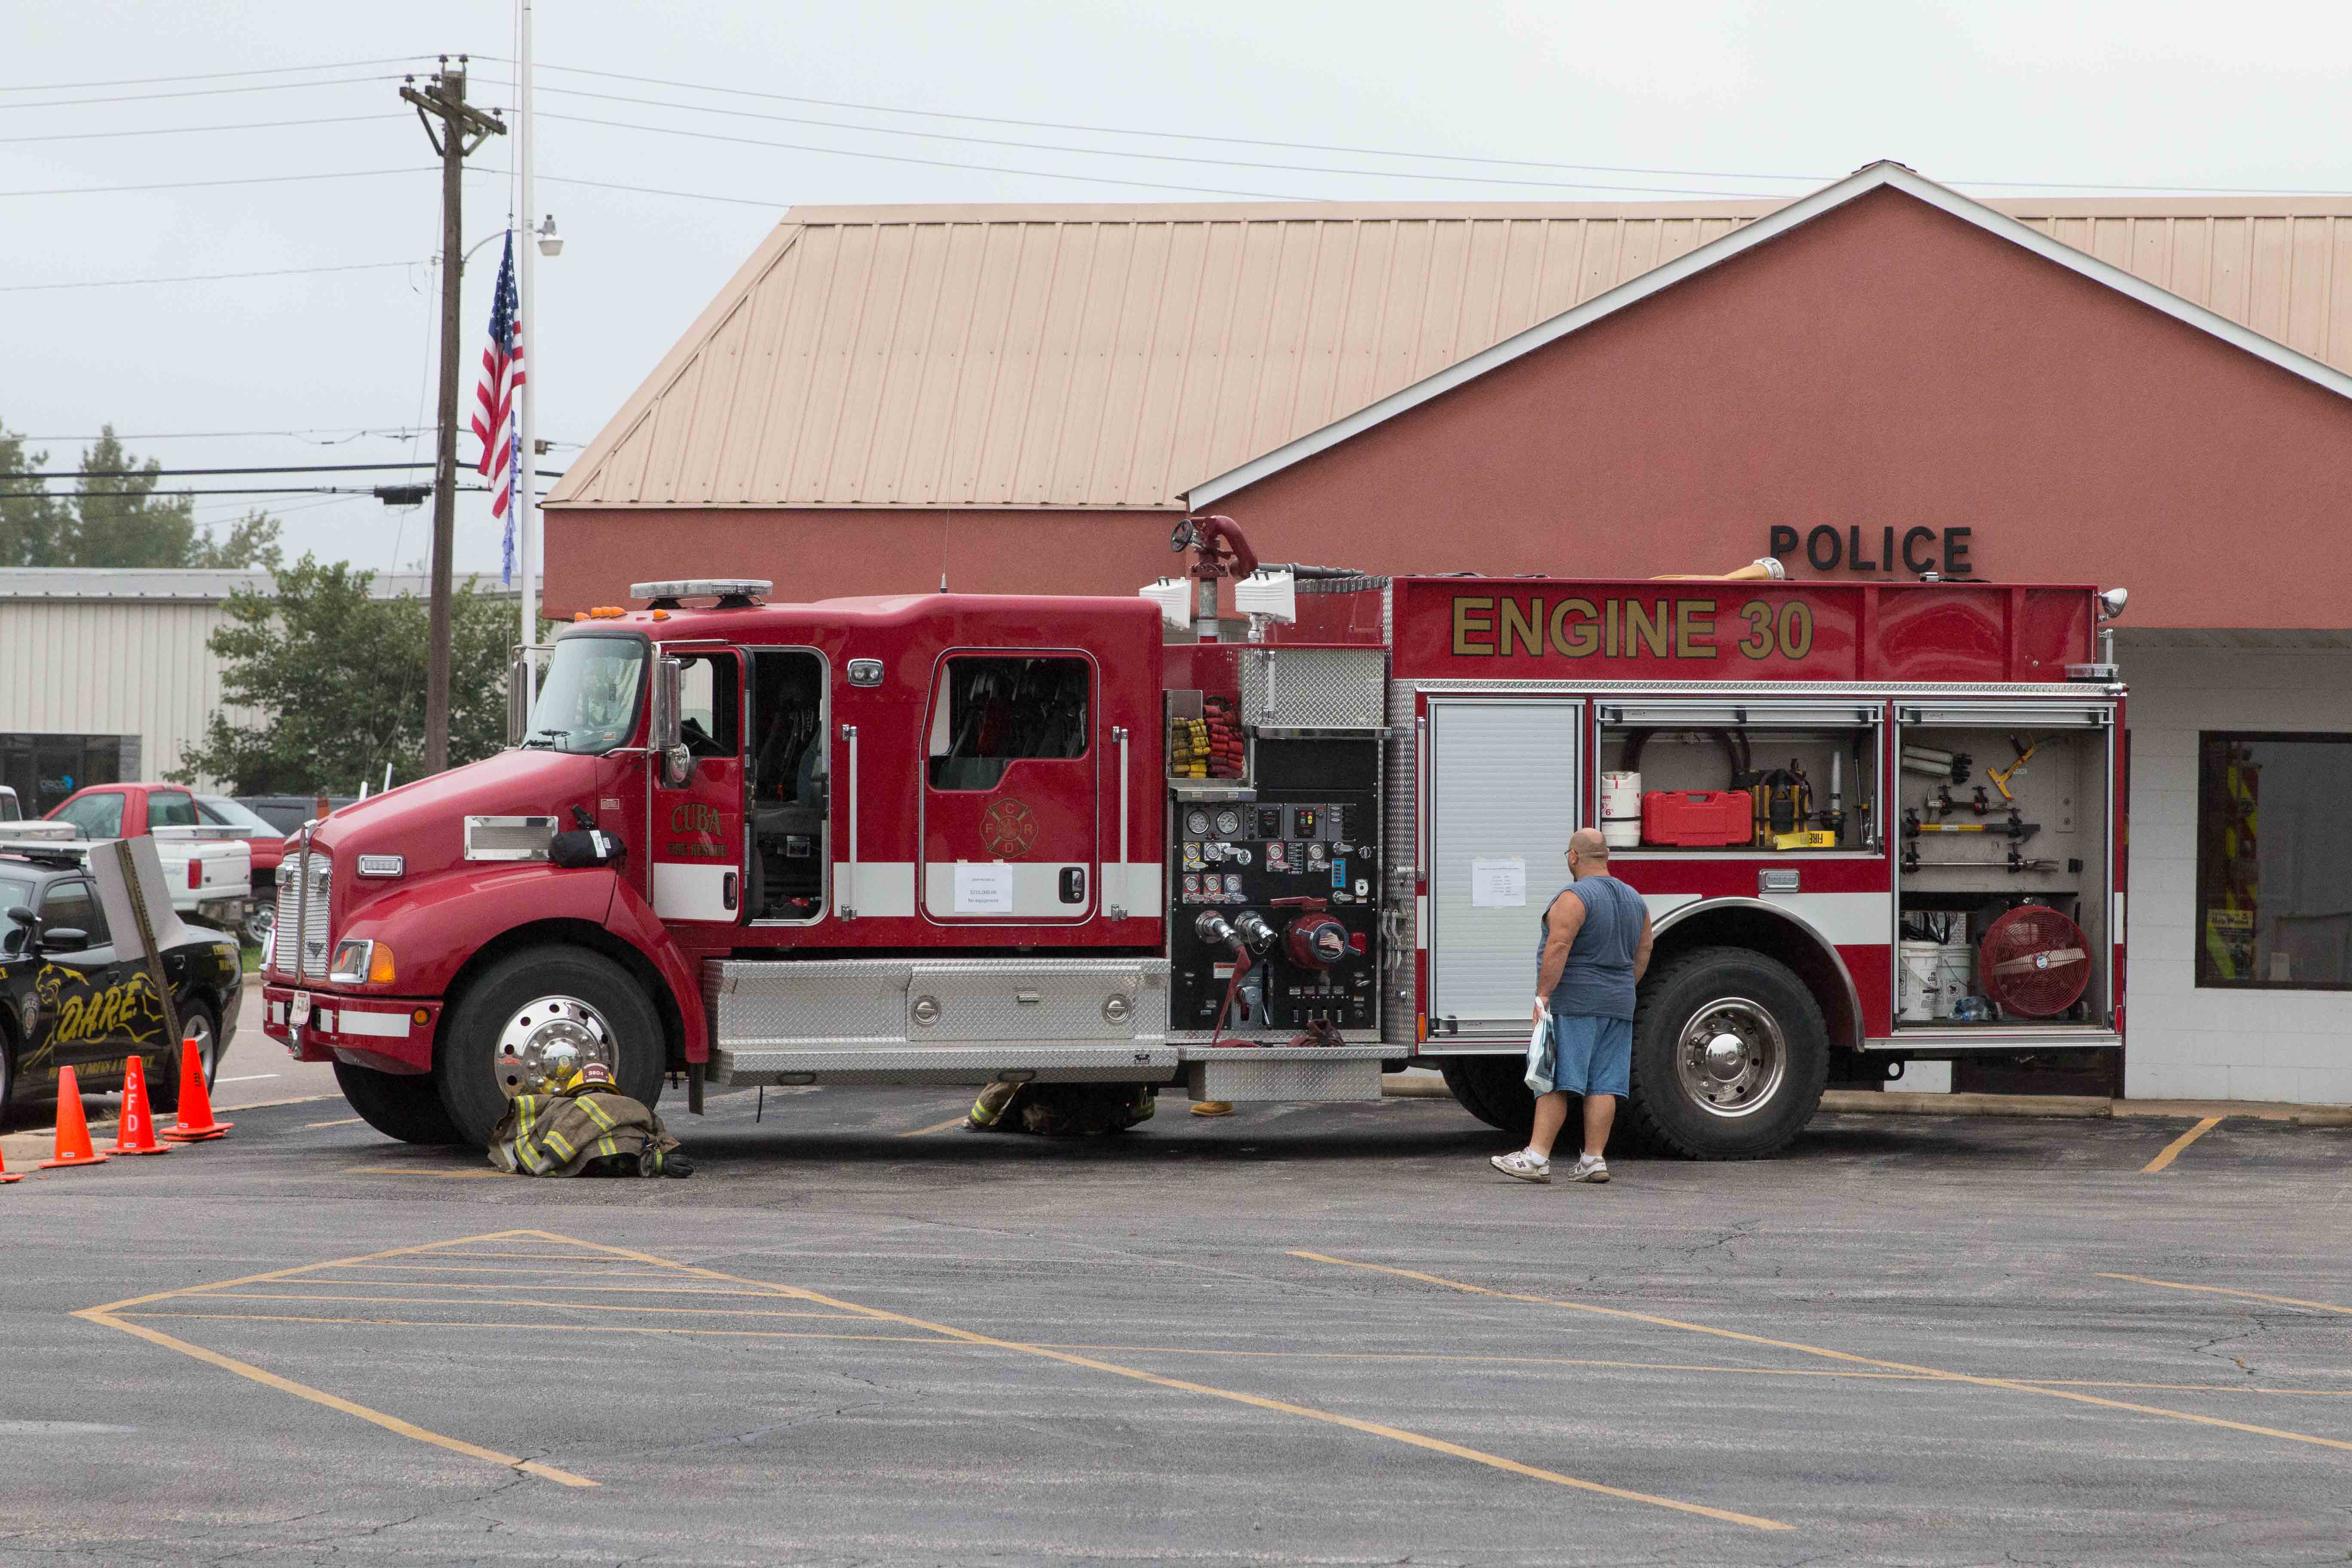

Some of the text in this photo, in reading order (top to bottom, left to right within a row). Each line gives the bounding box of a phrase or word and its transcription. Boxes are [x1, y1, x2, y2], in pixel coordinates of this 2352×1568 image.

[1770, 524, 1972, 573] POLICE
[1452, 596, 1814, 661] ENGINE 30
[671, 802, 723, 837] CUBA
[1809, 833, 1822, 843] FIRE
[667, 842, 726, 857] FIRE RESCUE
[127, 1073, 138, 1132] CFD
